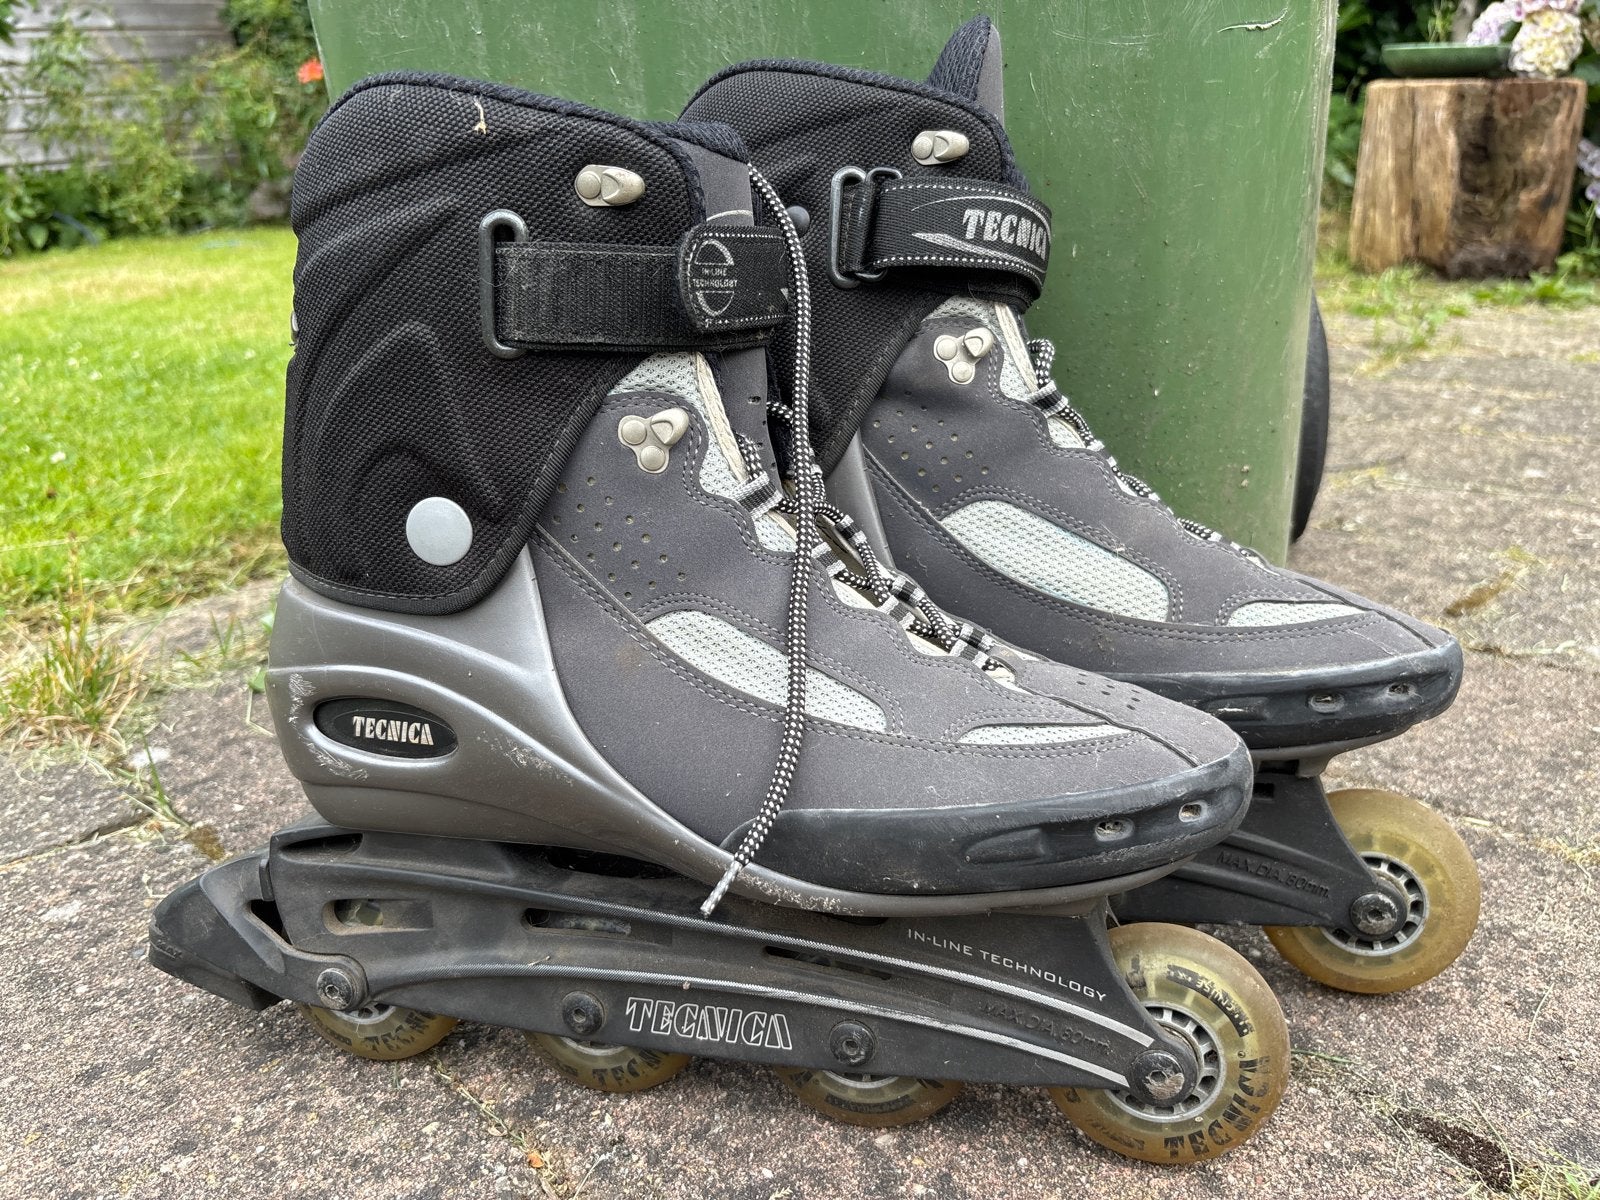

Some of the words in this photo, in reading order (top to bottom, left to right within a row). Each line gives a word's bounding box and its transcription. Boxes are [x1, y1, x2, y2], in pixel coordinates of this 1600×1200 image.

[693, 278, 738, 288] TECHNOLOGY
[352, 715, 435, 746] TECNICA
[907, 928, 974, 956] IN-LINE
[979, 949, 1107, 1002] TECHNOLOGY
[625, 996, 793, 1051] TECNICA
[591, 1048, 668, 1088] TECN
